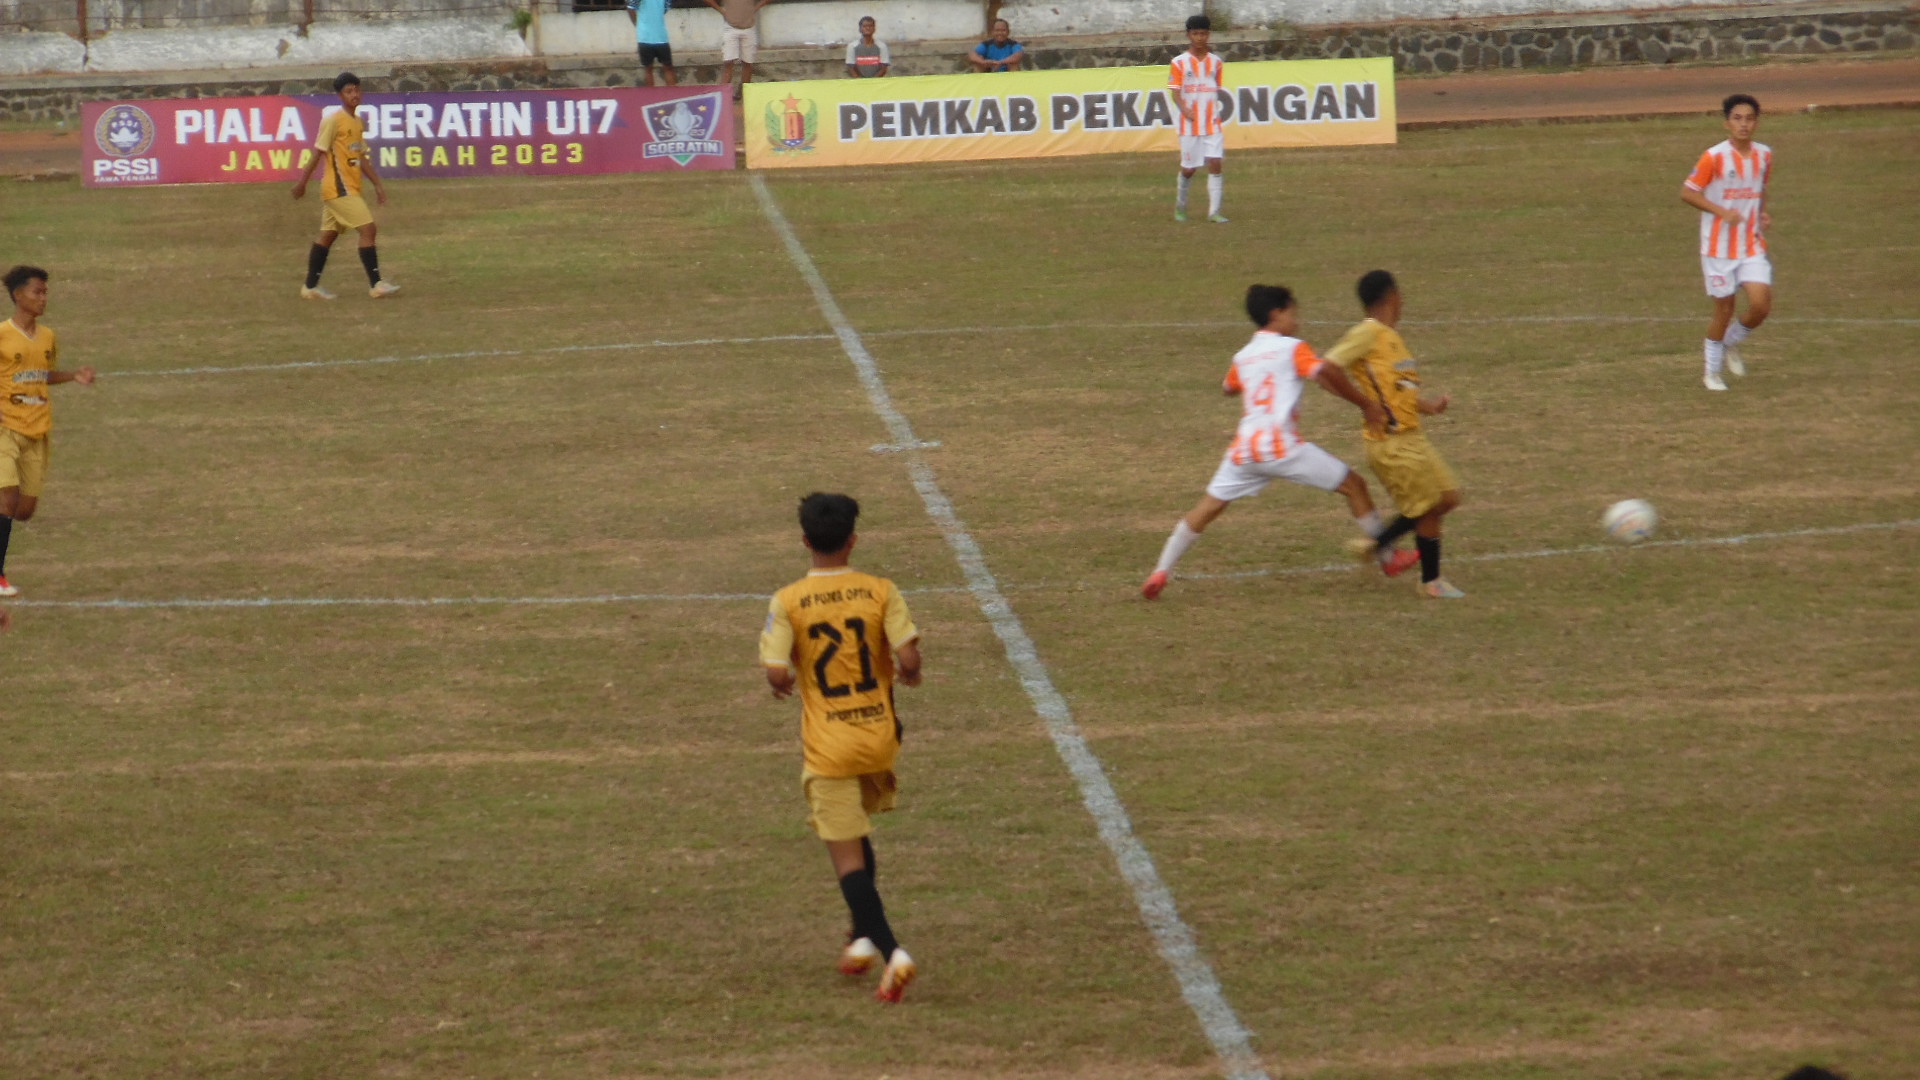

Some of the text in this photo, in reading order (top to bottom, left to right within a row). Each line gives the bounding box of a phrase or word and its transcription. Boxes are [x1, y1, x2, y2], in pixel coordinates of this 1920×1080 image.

[175, 99, 619, 144] PIALA OERATIN U17
[838, 82, 1377, 140] PEMKAB PEKAONGAN
[93, 157, 158, 177] PSSI
[364, 145, 475, 167] NGAH
[491, 143, 583, 165] 2023
[648, 141, 719, 155] SOERATIN
[1252, 371, 1276, 415] 4
[808, 617, 878, 698] 21
